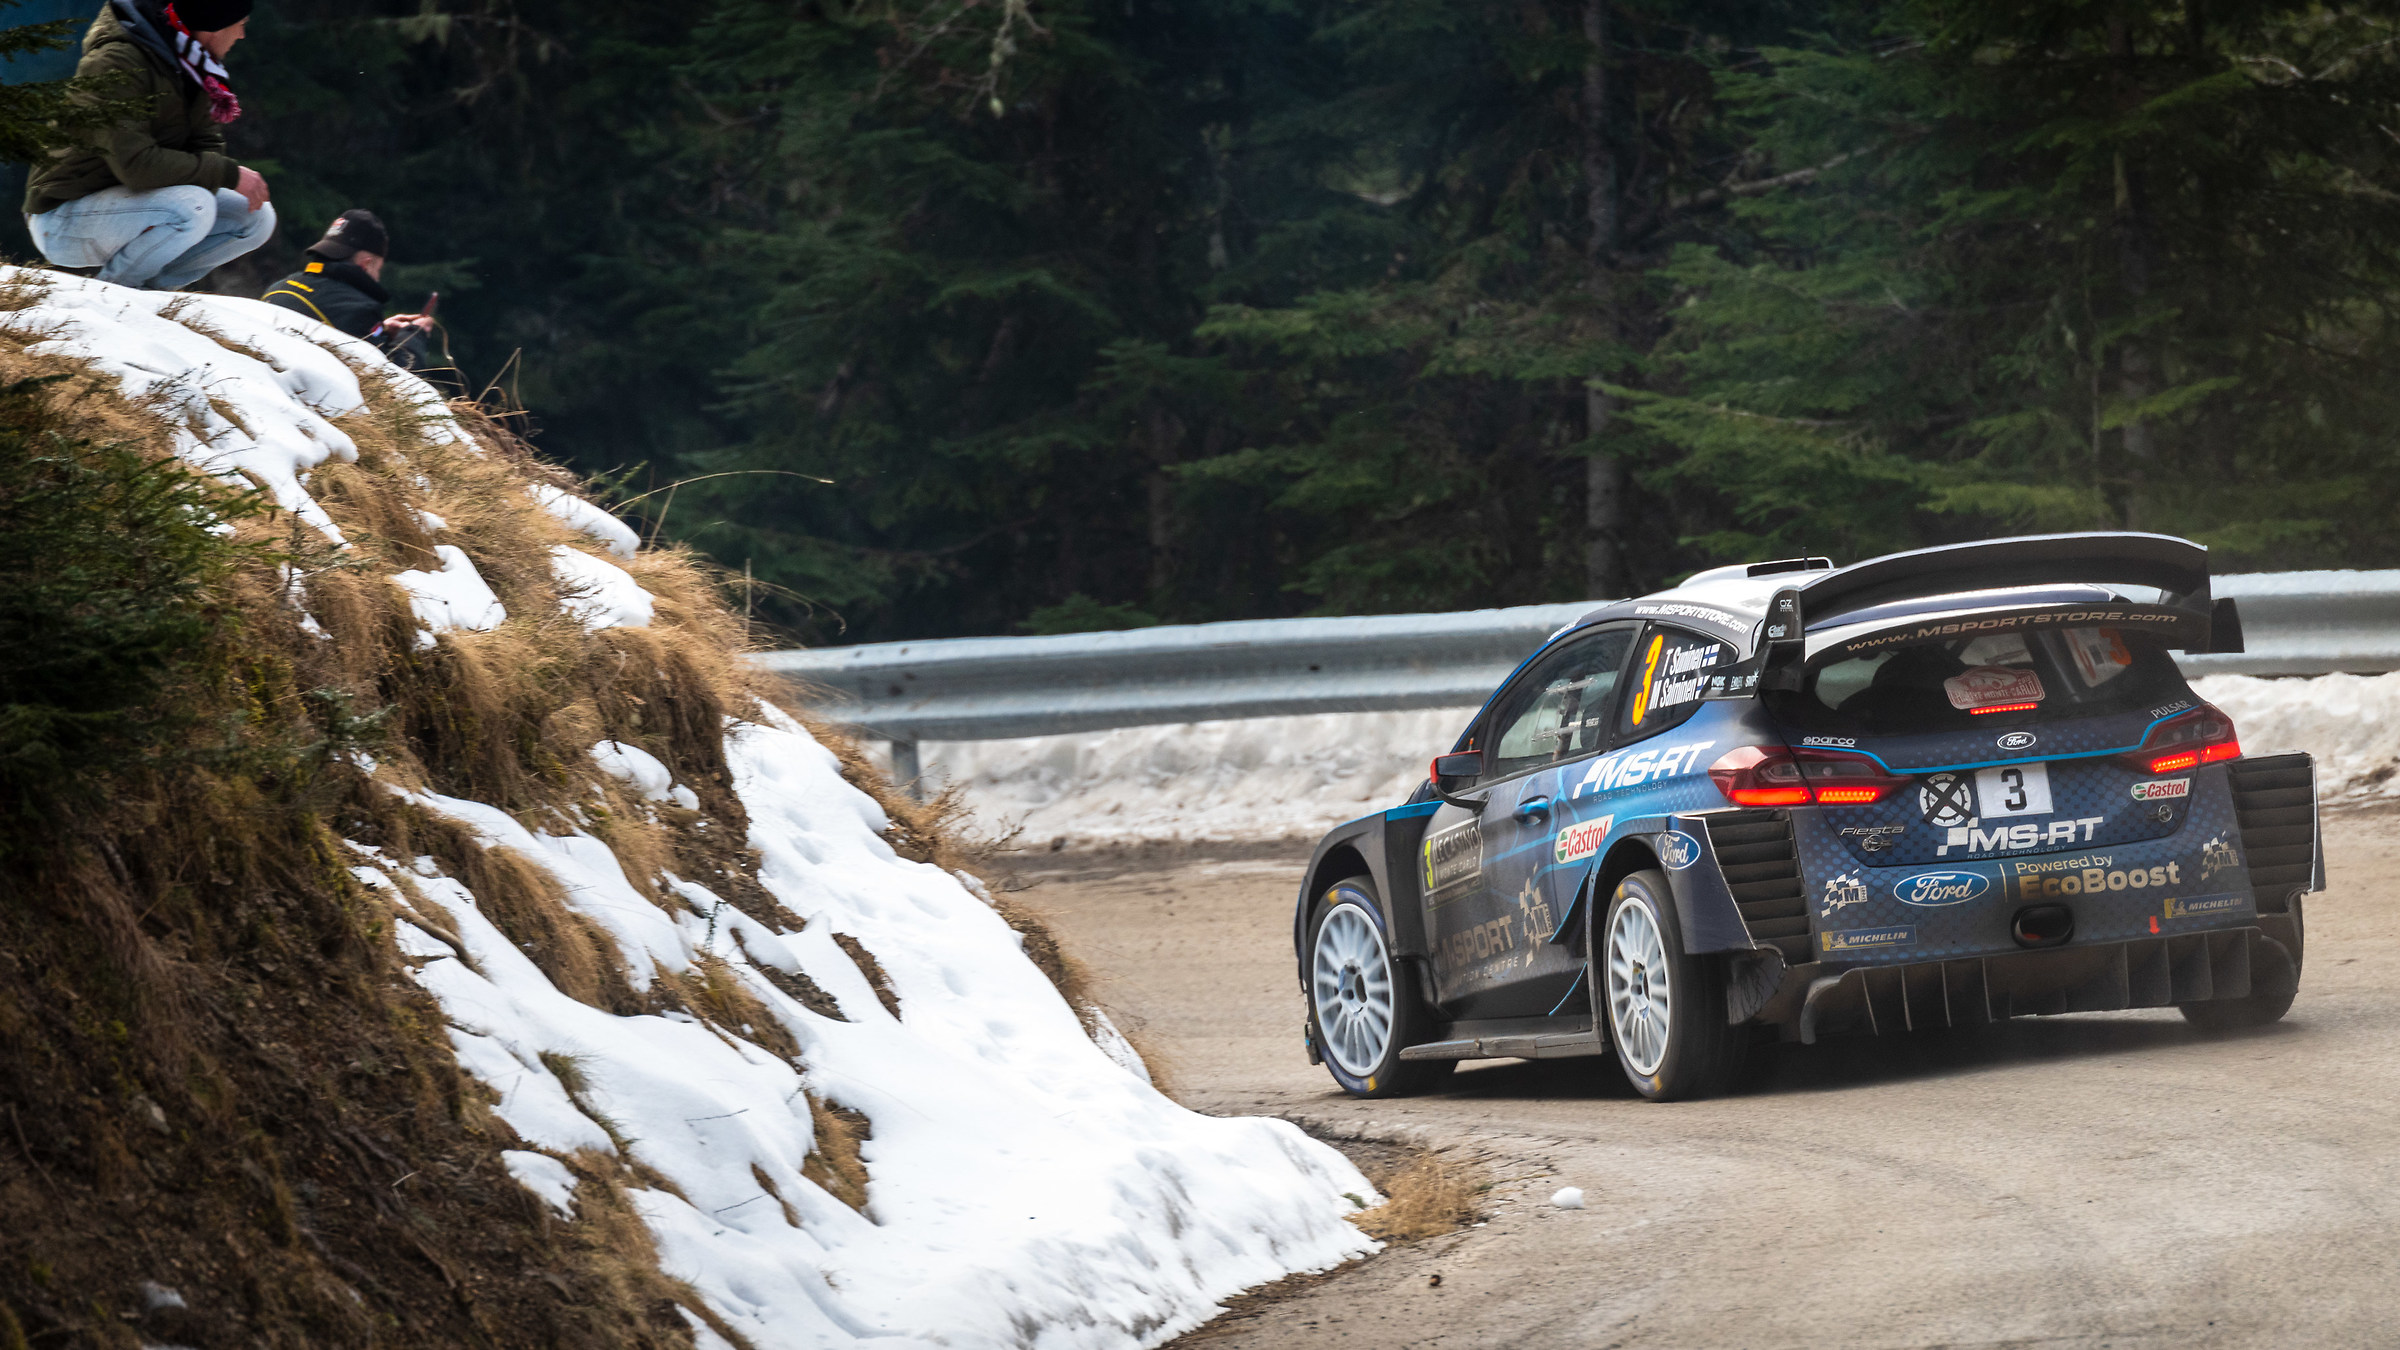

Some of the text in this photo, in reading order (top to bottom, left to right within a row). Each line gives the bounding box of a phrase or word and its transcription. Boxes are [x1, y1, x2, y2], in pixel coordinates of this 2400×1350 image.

[1846, 611, 2177, 651] www.MSPORTSTORE.com
[1632, 634, 1664, 725] 3
[1648, 680, 1662, 710] M
[2151, 700, 2192, 719] PULSAR
[2006, 736, 2028, 747] Ford
[1593, 740, 1716, 793] MS-RT
[1616, 781, 1667, 797] TECHNOLOGY
[2001, 768, 2028, 812] 3
[2147, 781, 2186, 798] Castrol
[1567, 820, 1609, 857] Castrol
[1662, 834, 1689, 864] Ford
[1968, 816, 2103, 853] MS-RT
[1424, 840, 1433, 889] 3
[2001, 845, 2066, 856] TECHNOLOGY
[2015, 855, 2112, 874] Powered by
[1911, 875, 1973, 902] Ford
[2019, 860, 2180, 900] EcoBoost
[2189, 898, 2243, 911] MICHELIN
[1849, 932, 1908, 943] MICHELIN
